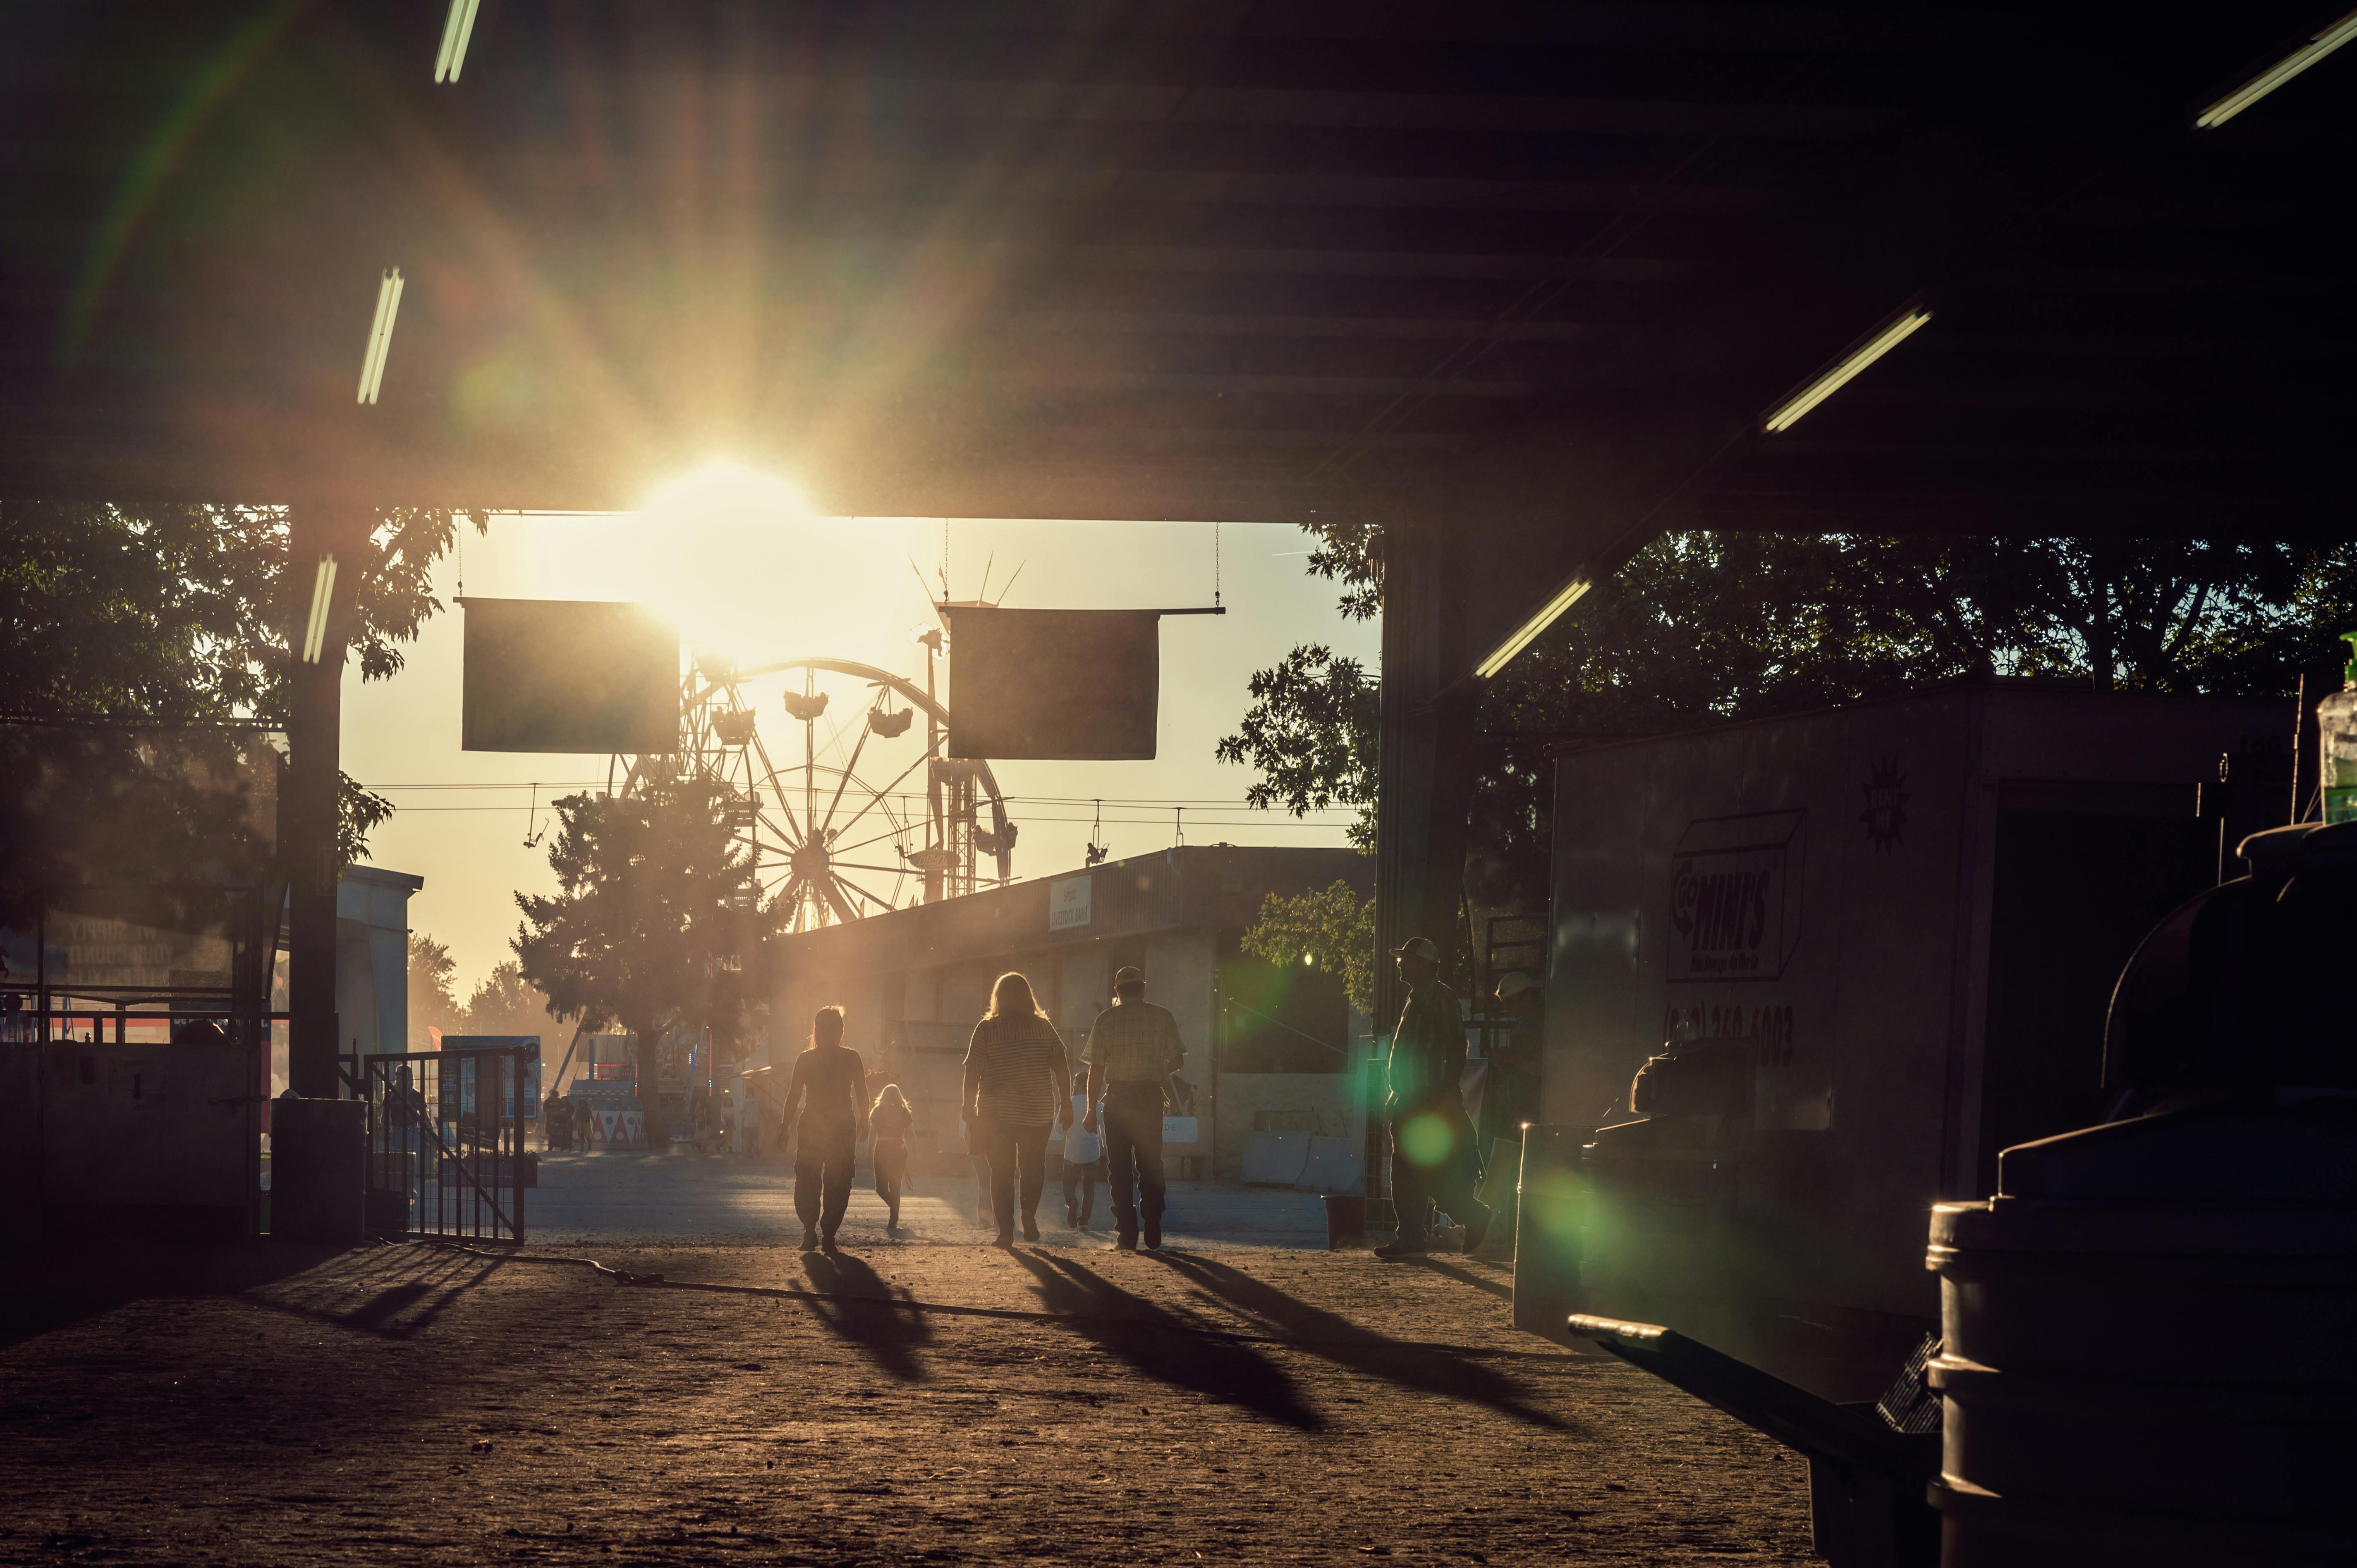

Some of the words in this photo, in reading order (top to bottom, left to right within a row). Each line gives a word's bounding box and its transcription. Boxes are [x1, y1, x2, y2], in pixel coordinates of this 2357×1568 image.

[1870, 787, 1897, 808] RENT
[1876, 810, 1892, 829] ME
[1052, 907, 1074, 927] LIVESTOCK
[1075, 906, 1087, 922] BARN
[1677, 876, 1698, 908] GO
[1691, 868, 1770, 951] MINI'S
[1690, 956, 1704, 973] Mini
[1704, 954, 1728, 975] Storage
